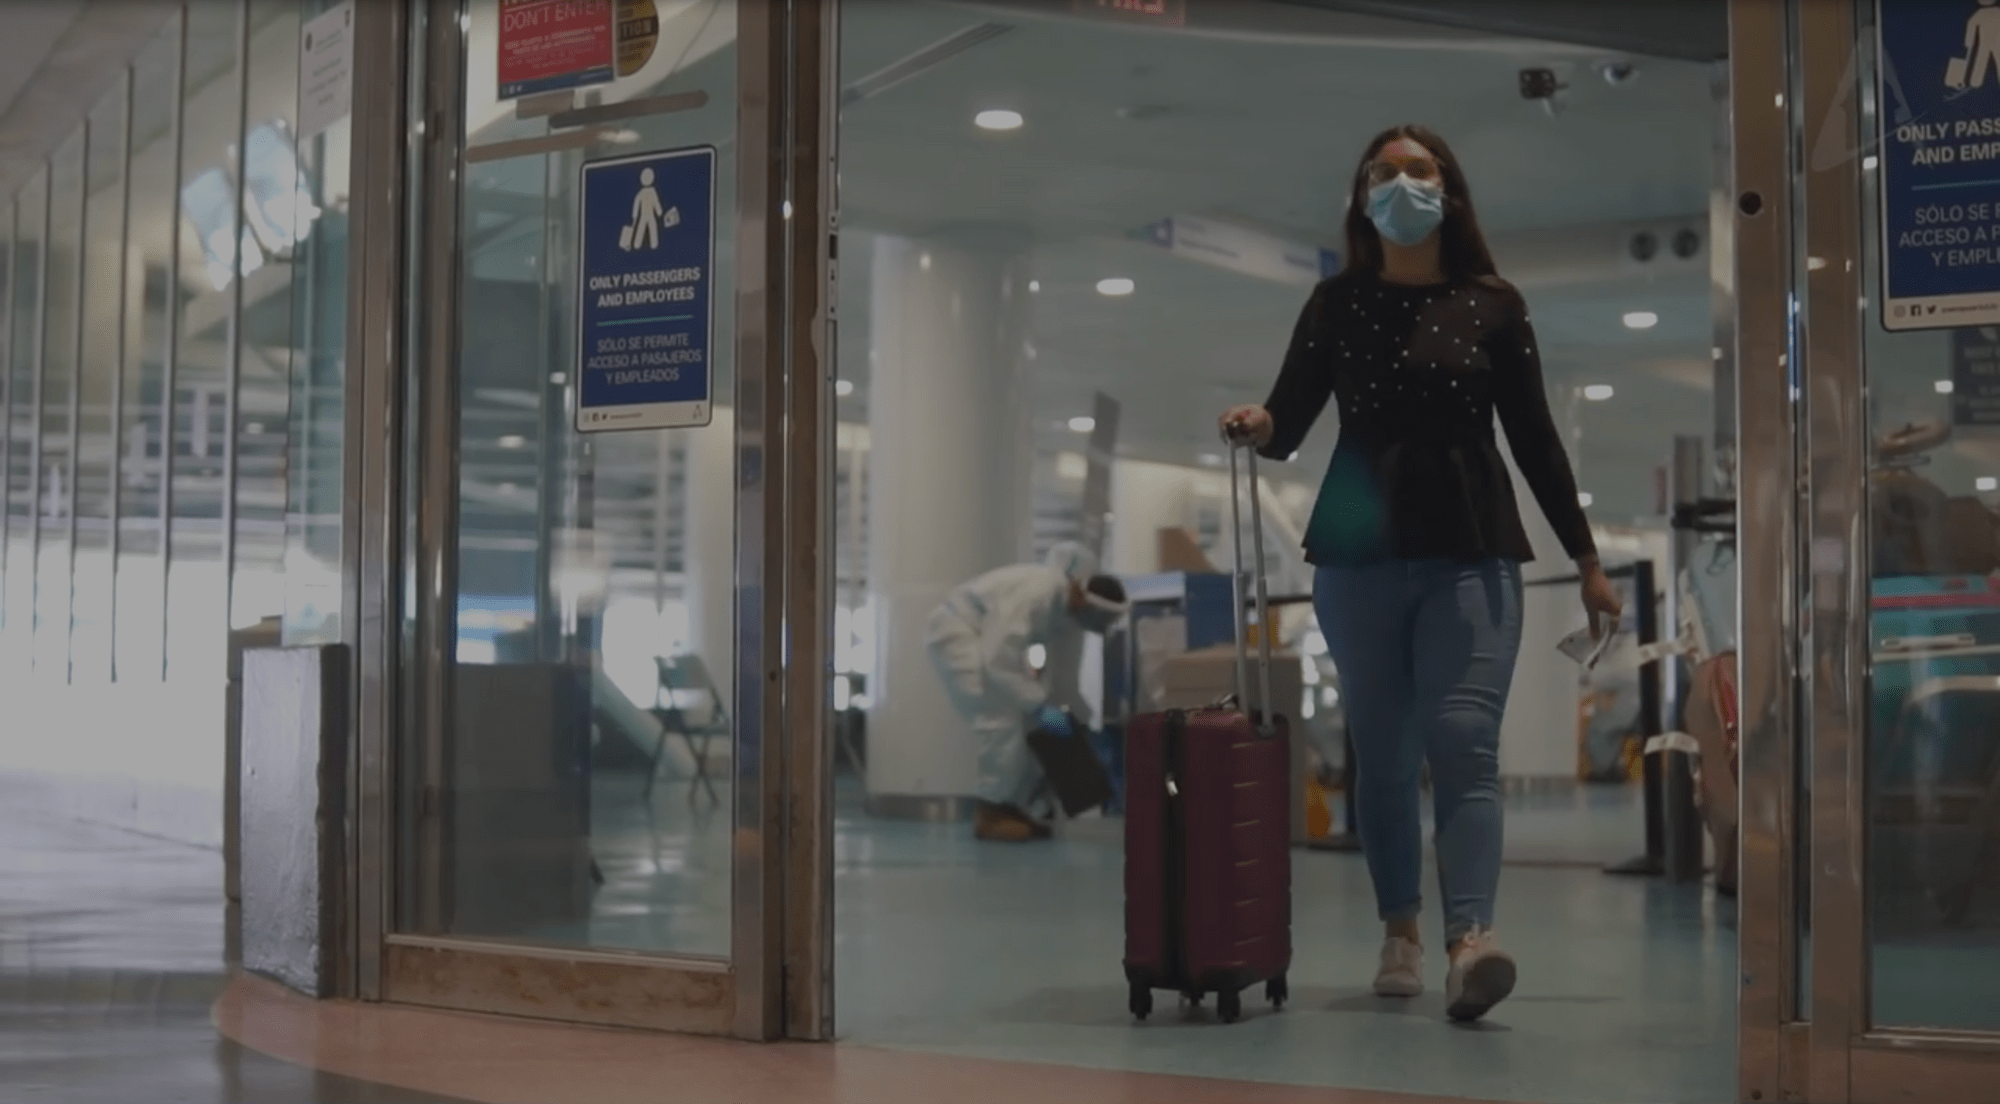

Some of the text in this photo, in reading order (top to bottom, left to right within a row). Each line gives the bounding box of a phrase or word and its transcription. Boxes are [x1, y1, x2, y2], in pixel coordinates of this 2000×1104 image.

[556, 0, 608, 22] ENTER
[617, 19, 652, 40] TION
[1897, 122, 1949, 143] ONLY
[1911, 142, 2000, 167] AND EMP
[1915, 202, 1963, 225] SÓLO
[1967, 203, 1990, 221] SE
[1898, 227, 1970, 248] ACCESO
[1974, 225, 1988, 243] A
[1931, 250, 1944, 267] Y
[589, 266, 701, 290] ONLY PASSENGERS
[597, 285, 695, 308] AND EMPLOYEES
[597, 332, 689, 353] SÓLO SE PERMITE
[587, 348, 702, 369] ACCESO A PASAJEROS
[605, 367, 680, 385] Y EMPLEADOS
